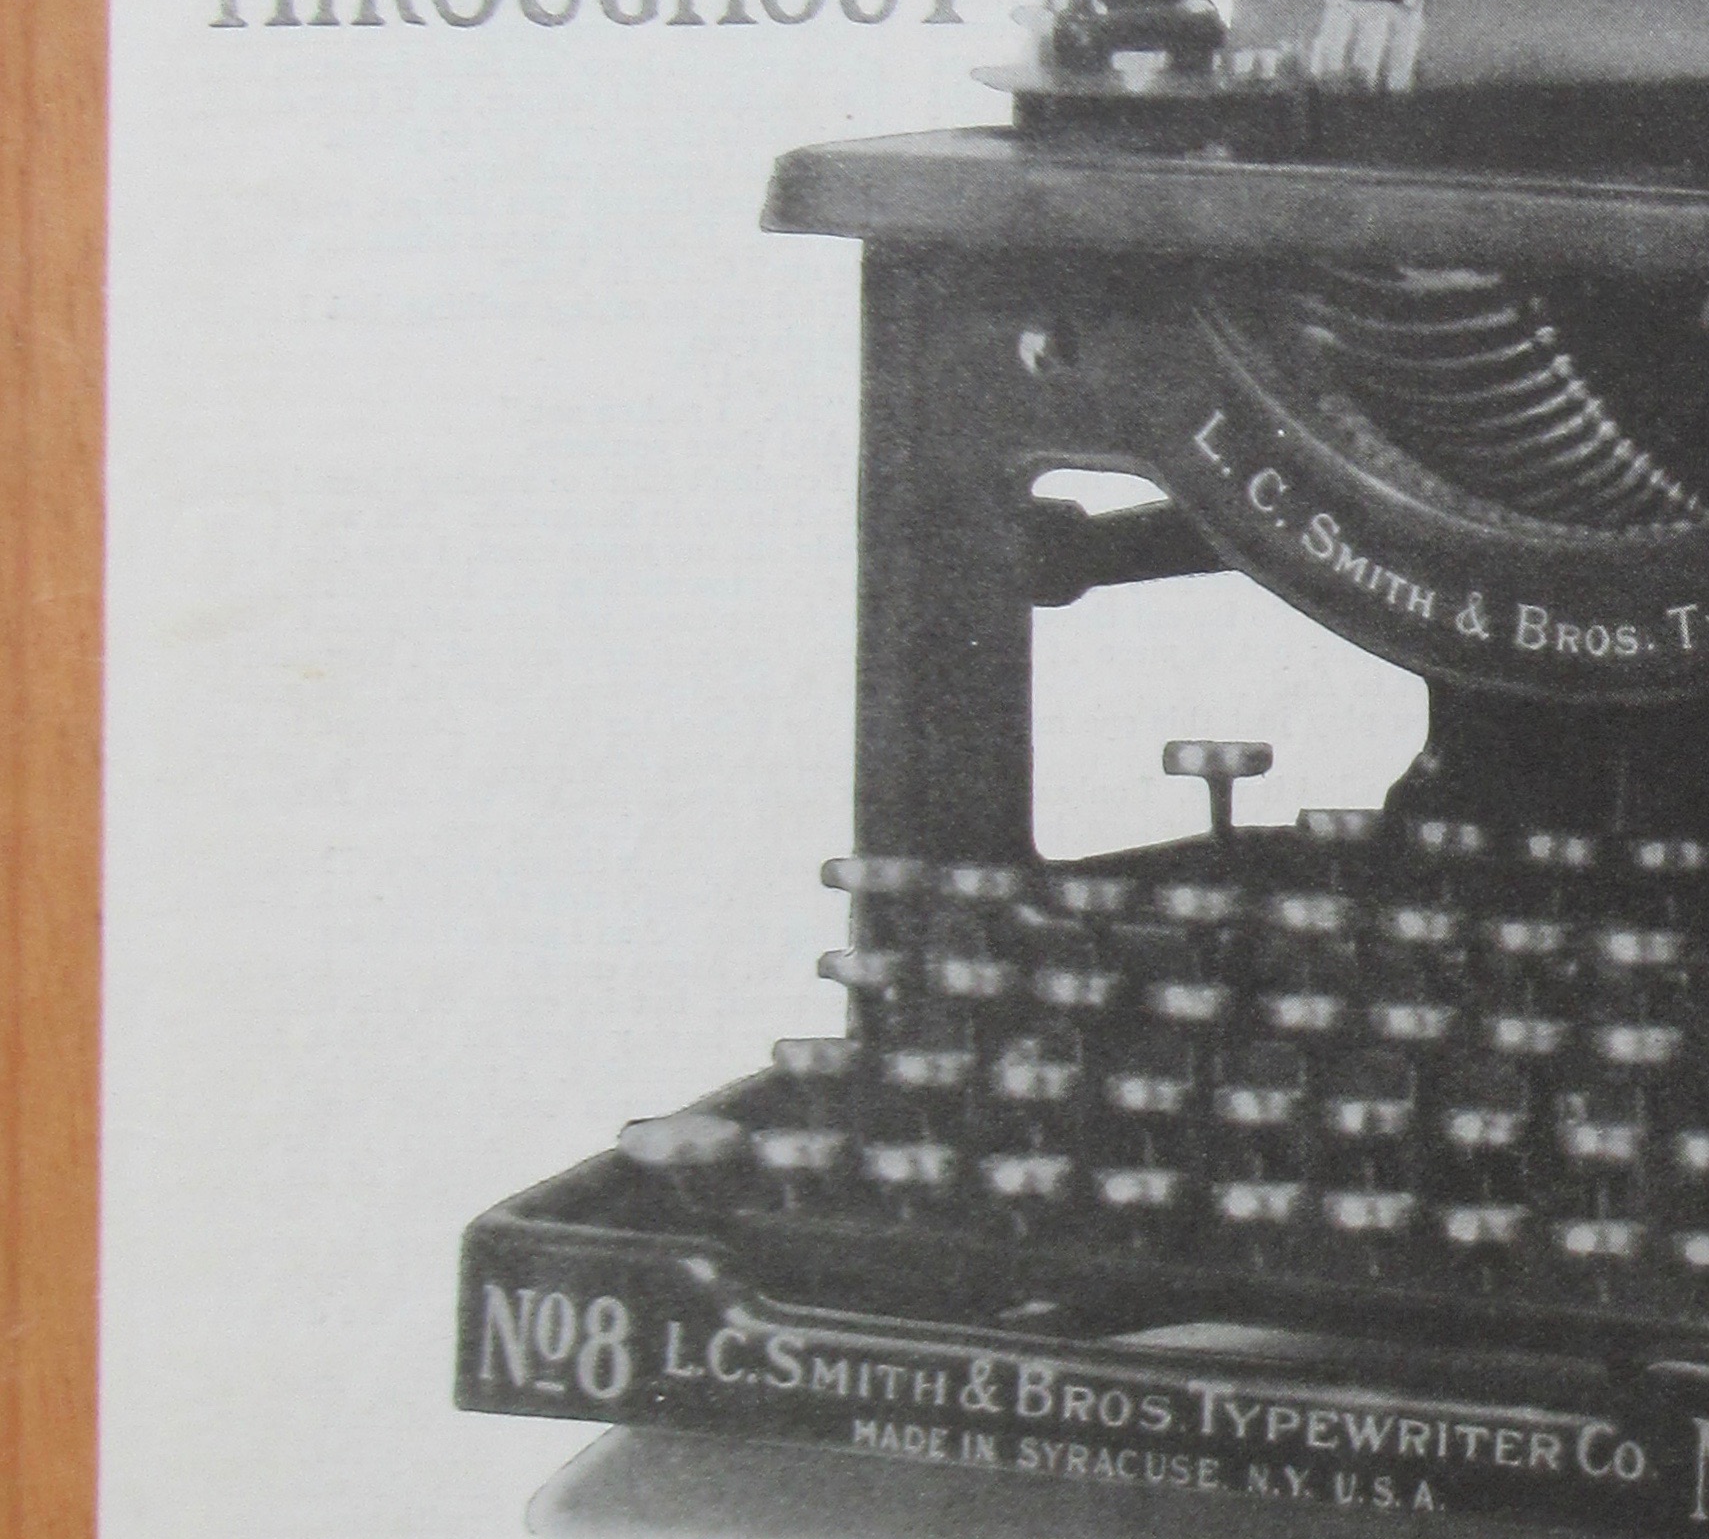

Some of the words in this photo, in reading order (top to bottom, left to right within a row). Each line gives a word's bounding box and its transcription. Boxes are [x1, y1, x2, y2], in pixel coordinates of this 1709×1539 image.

[1193, 409, 1231, 477] L.
[1247, 467, 1288, 528] C.
[1455, 591, 1490, 640] &
[958, 1359, 1002, 1413] &
[852, 1418, 947, 1459] MADE
[959, 1431, 997, 1460] IN
